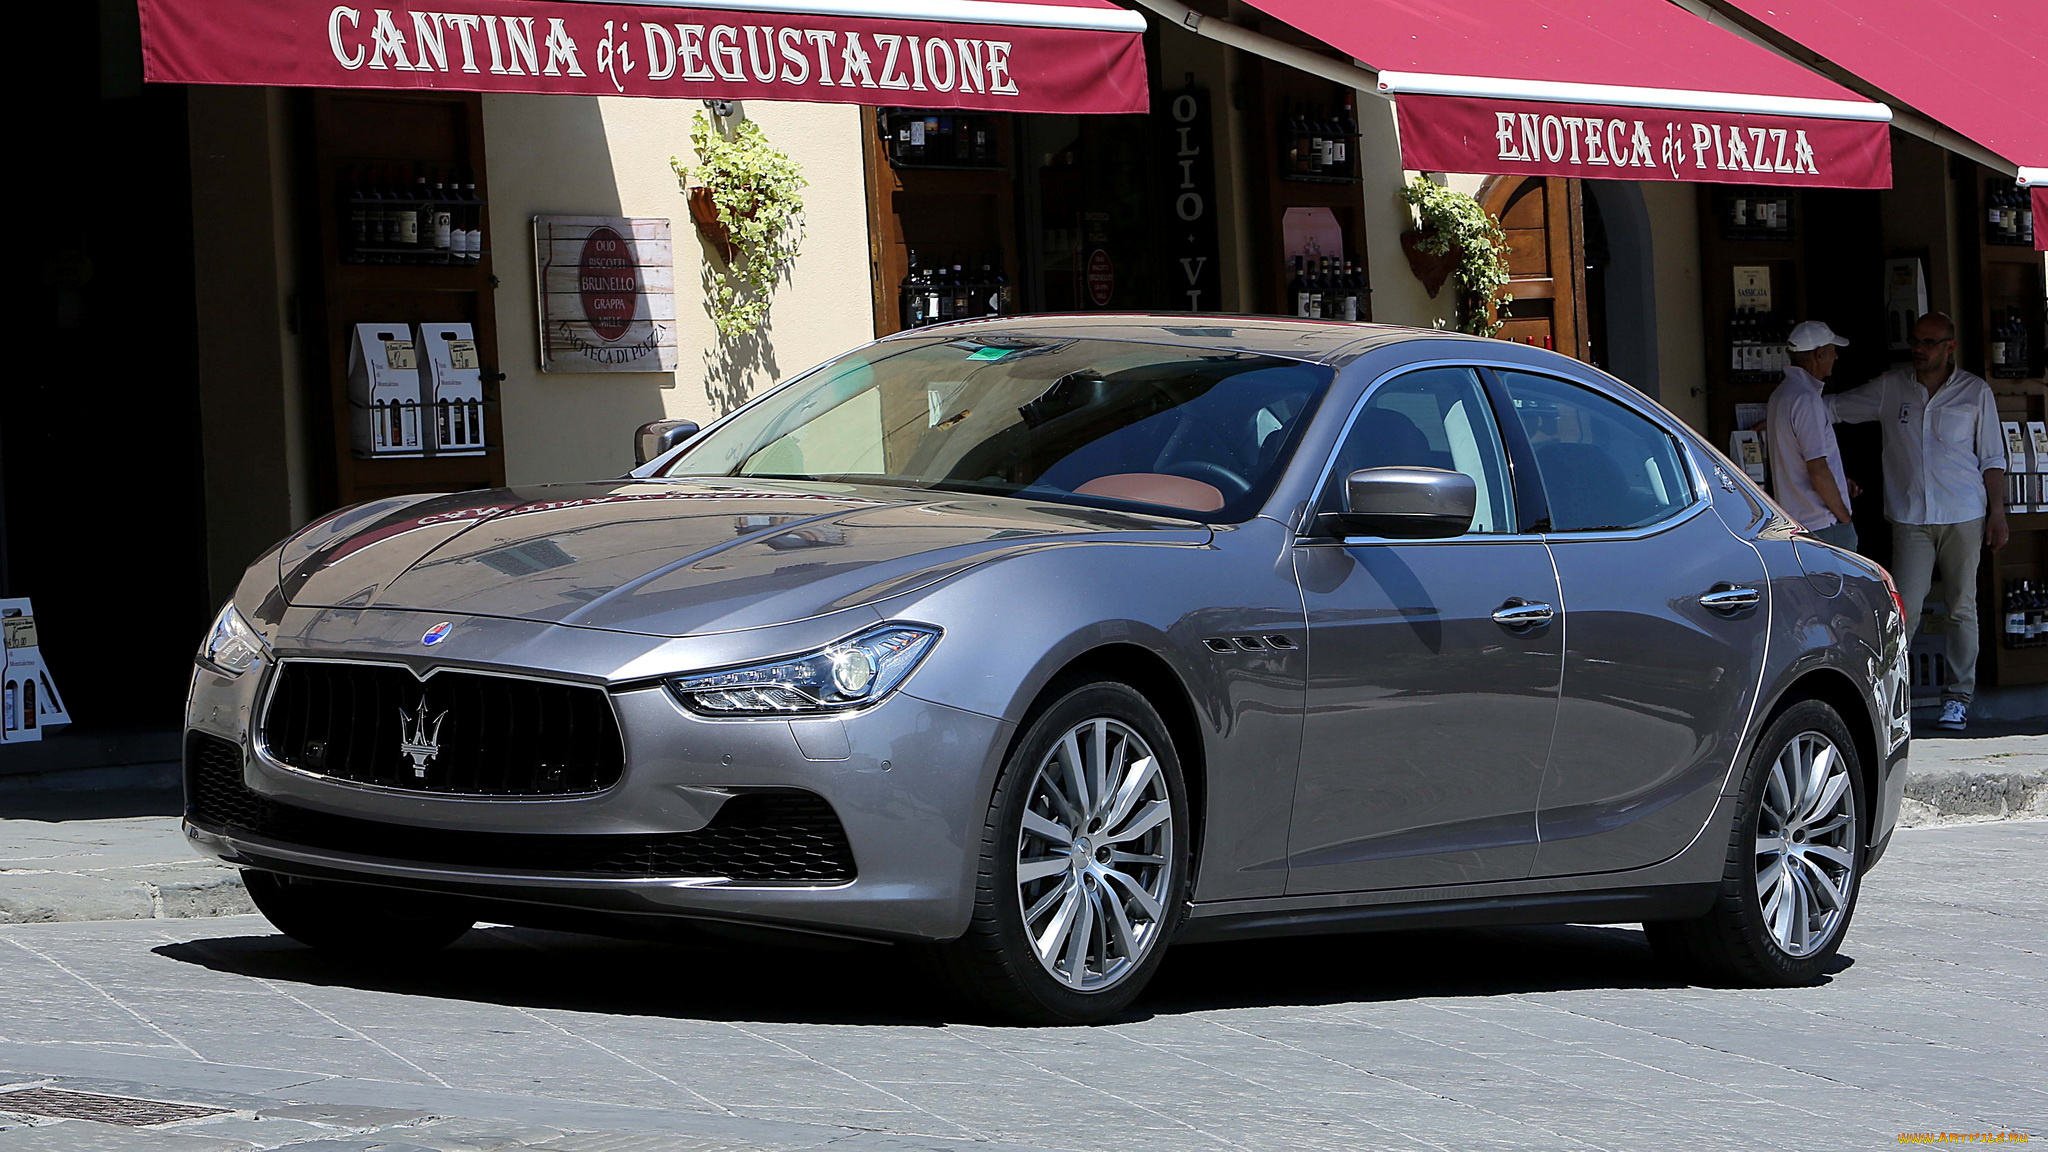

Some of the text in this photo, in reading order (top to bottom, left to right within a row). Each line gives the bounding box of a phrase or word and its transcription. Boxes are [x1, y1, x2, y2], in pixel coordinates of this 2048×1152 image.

[328, 5, 1020, 96] CANTINA di DEGUSTAZIONE
[1494, 111, 1820, 180] ENOTECA di PIAZZA
[1172, 95, 1204, 222] OLIO
[596, 240, 616, 252] OLIO
[589, 258, 626, 269] BISCOTTI
[582, 277, 635, 292] BRUNELLO
[594, 298, 626, 310] GRAPPA
[598, 316, 623, 328] MIELE
[558, 321, 667, 364] ENOTECA DI PIAZZA
